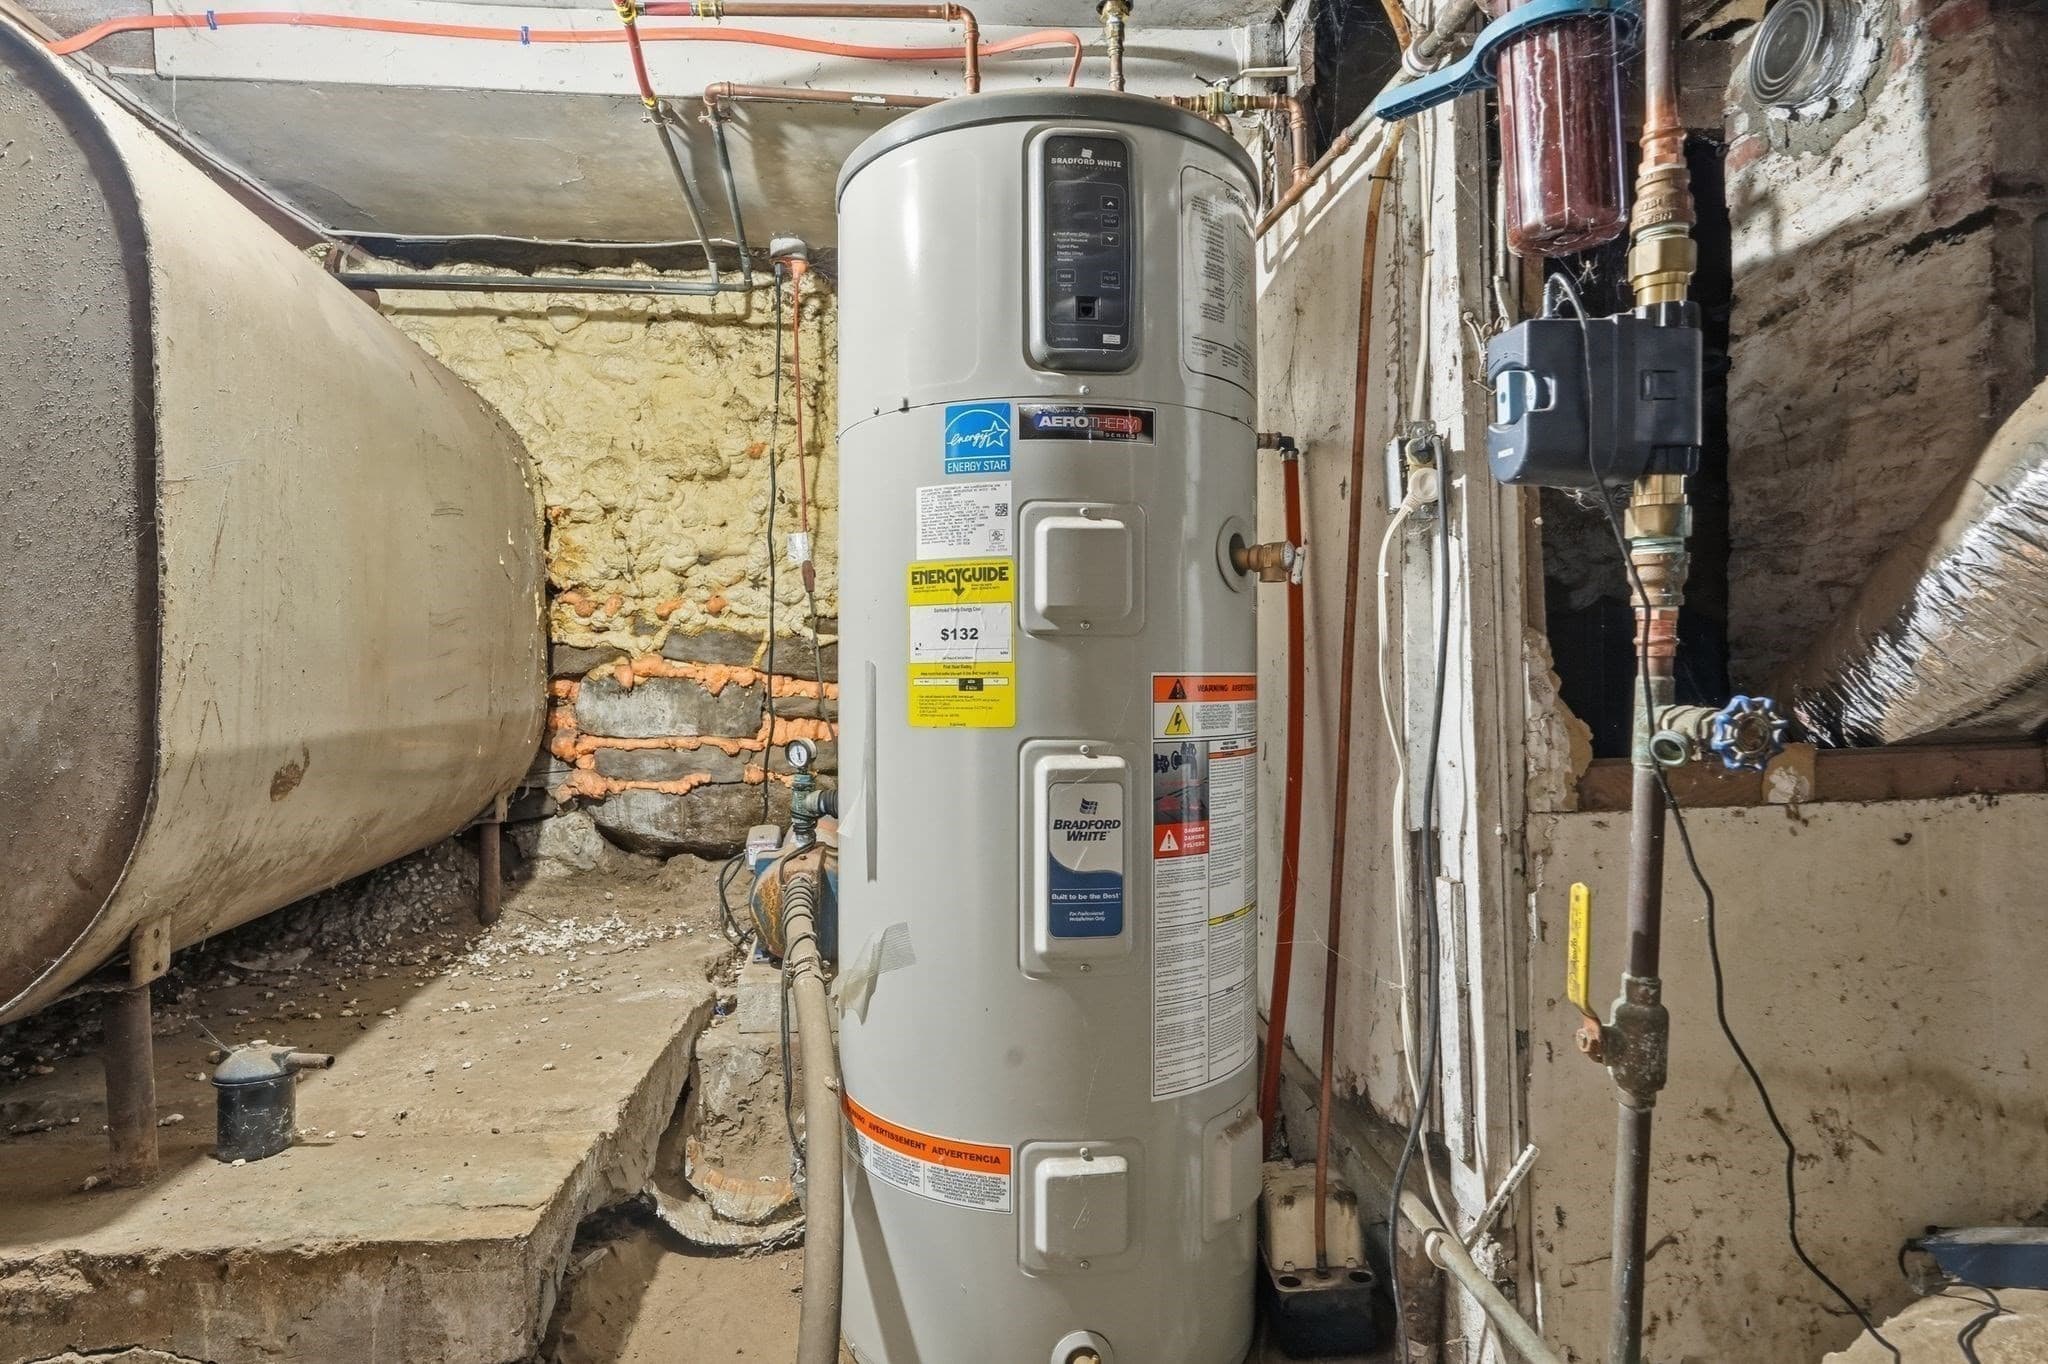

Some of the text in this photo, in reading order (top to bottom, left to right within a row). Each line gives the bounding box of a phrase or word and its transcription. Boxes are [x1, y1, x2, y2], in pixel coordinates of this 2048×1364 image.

[1050, 157, 1122, 168] BRADFORD WHITE
[1038, 415, 1138, 431] AEROTHERM
[947, 459, 1007, 473] ENERGY STAR
[911, 566, 1010, 586] ENERGYGUIDE
[940, 627, 979, 642] $132
[1197, 684, 1229, 692] WARNING
[1053, 819, 1122, 830] BRADFORD
[1066, 830, 1107, 842] WHITE
[868, 1122, 927, 1151] AVERTISSEMENT
[931, 1146, 1002, 1165] ADVERTENCIA
